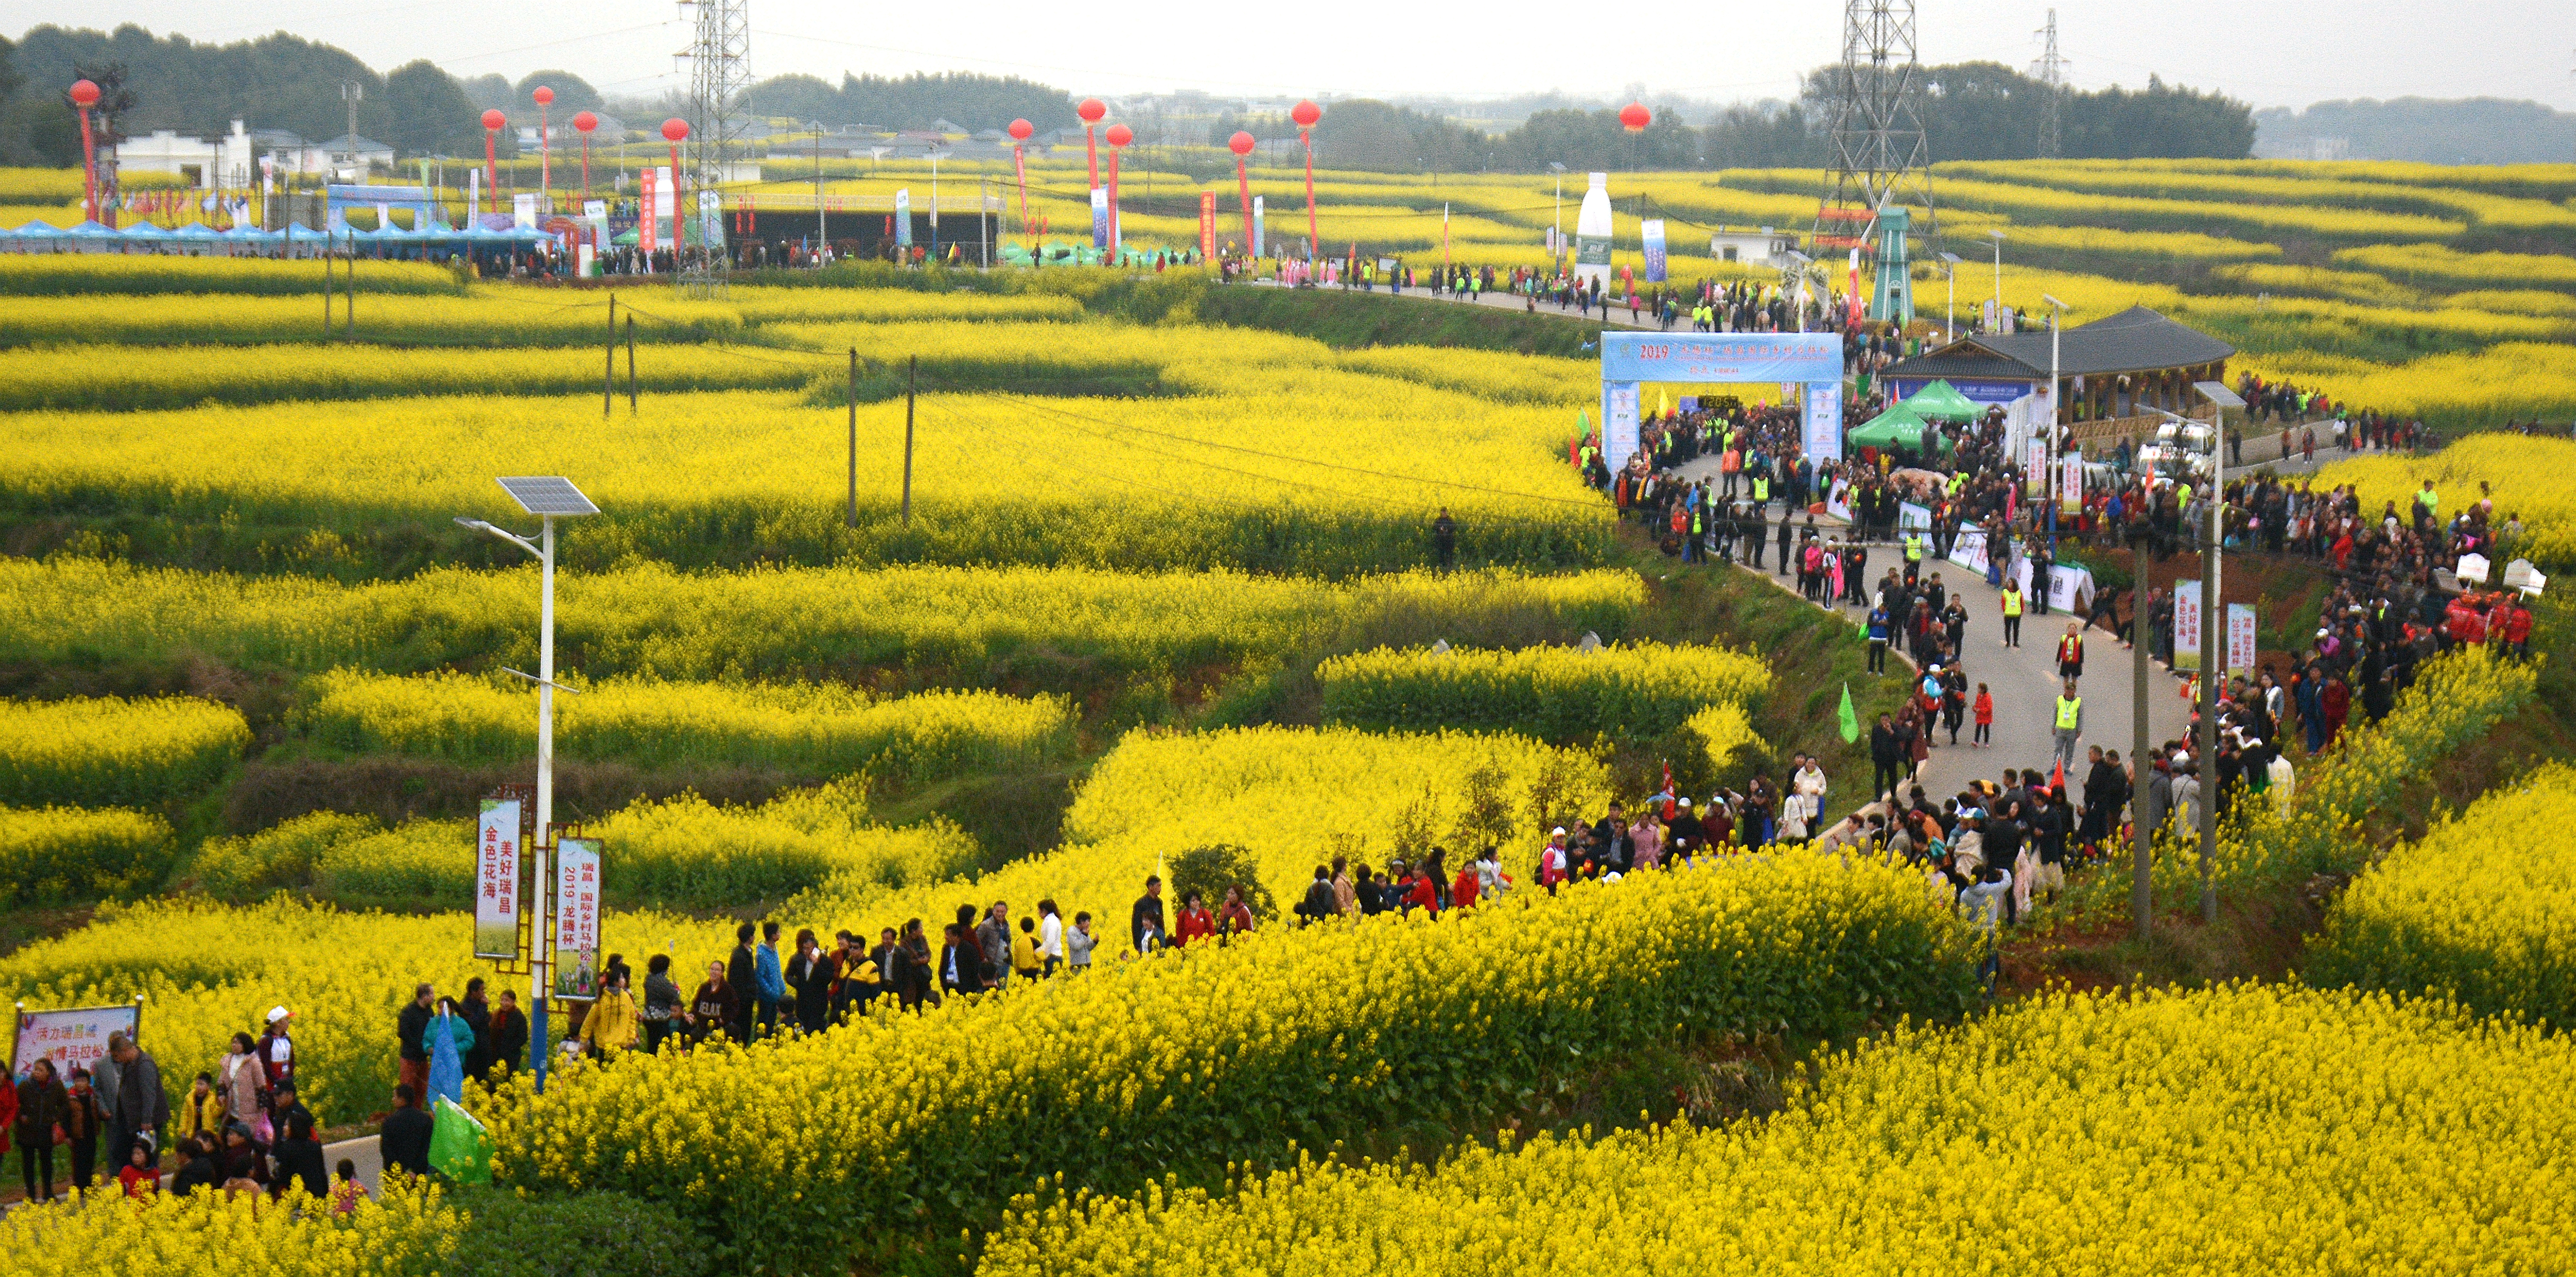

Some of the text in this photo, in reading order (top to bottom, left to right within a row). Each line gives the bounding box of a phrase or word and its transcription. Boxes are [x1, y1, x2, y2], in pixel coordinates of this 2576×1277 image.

[1640, 344, 1669, 360] 2019
[483, 825, 497, 898] 金色花海
[499, 840, 513, 914] 美好瑞昌
